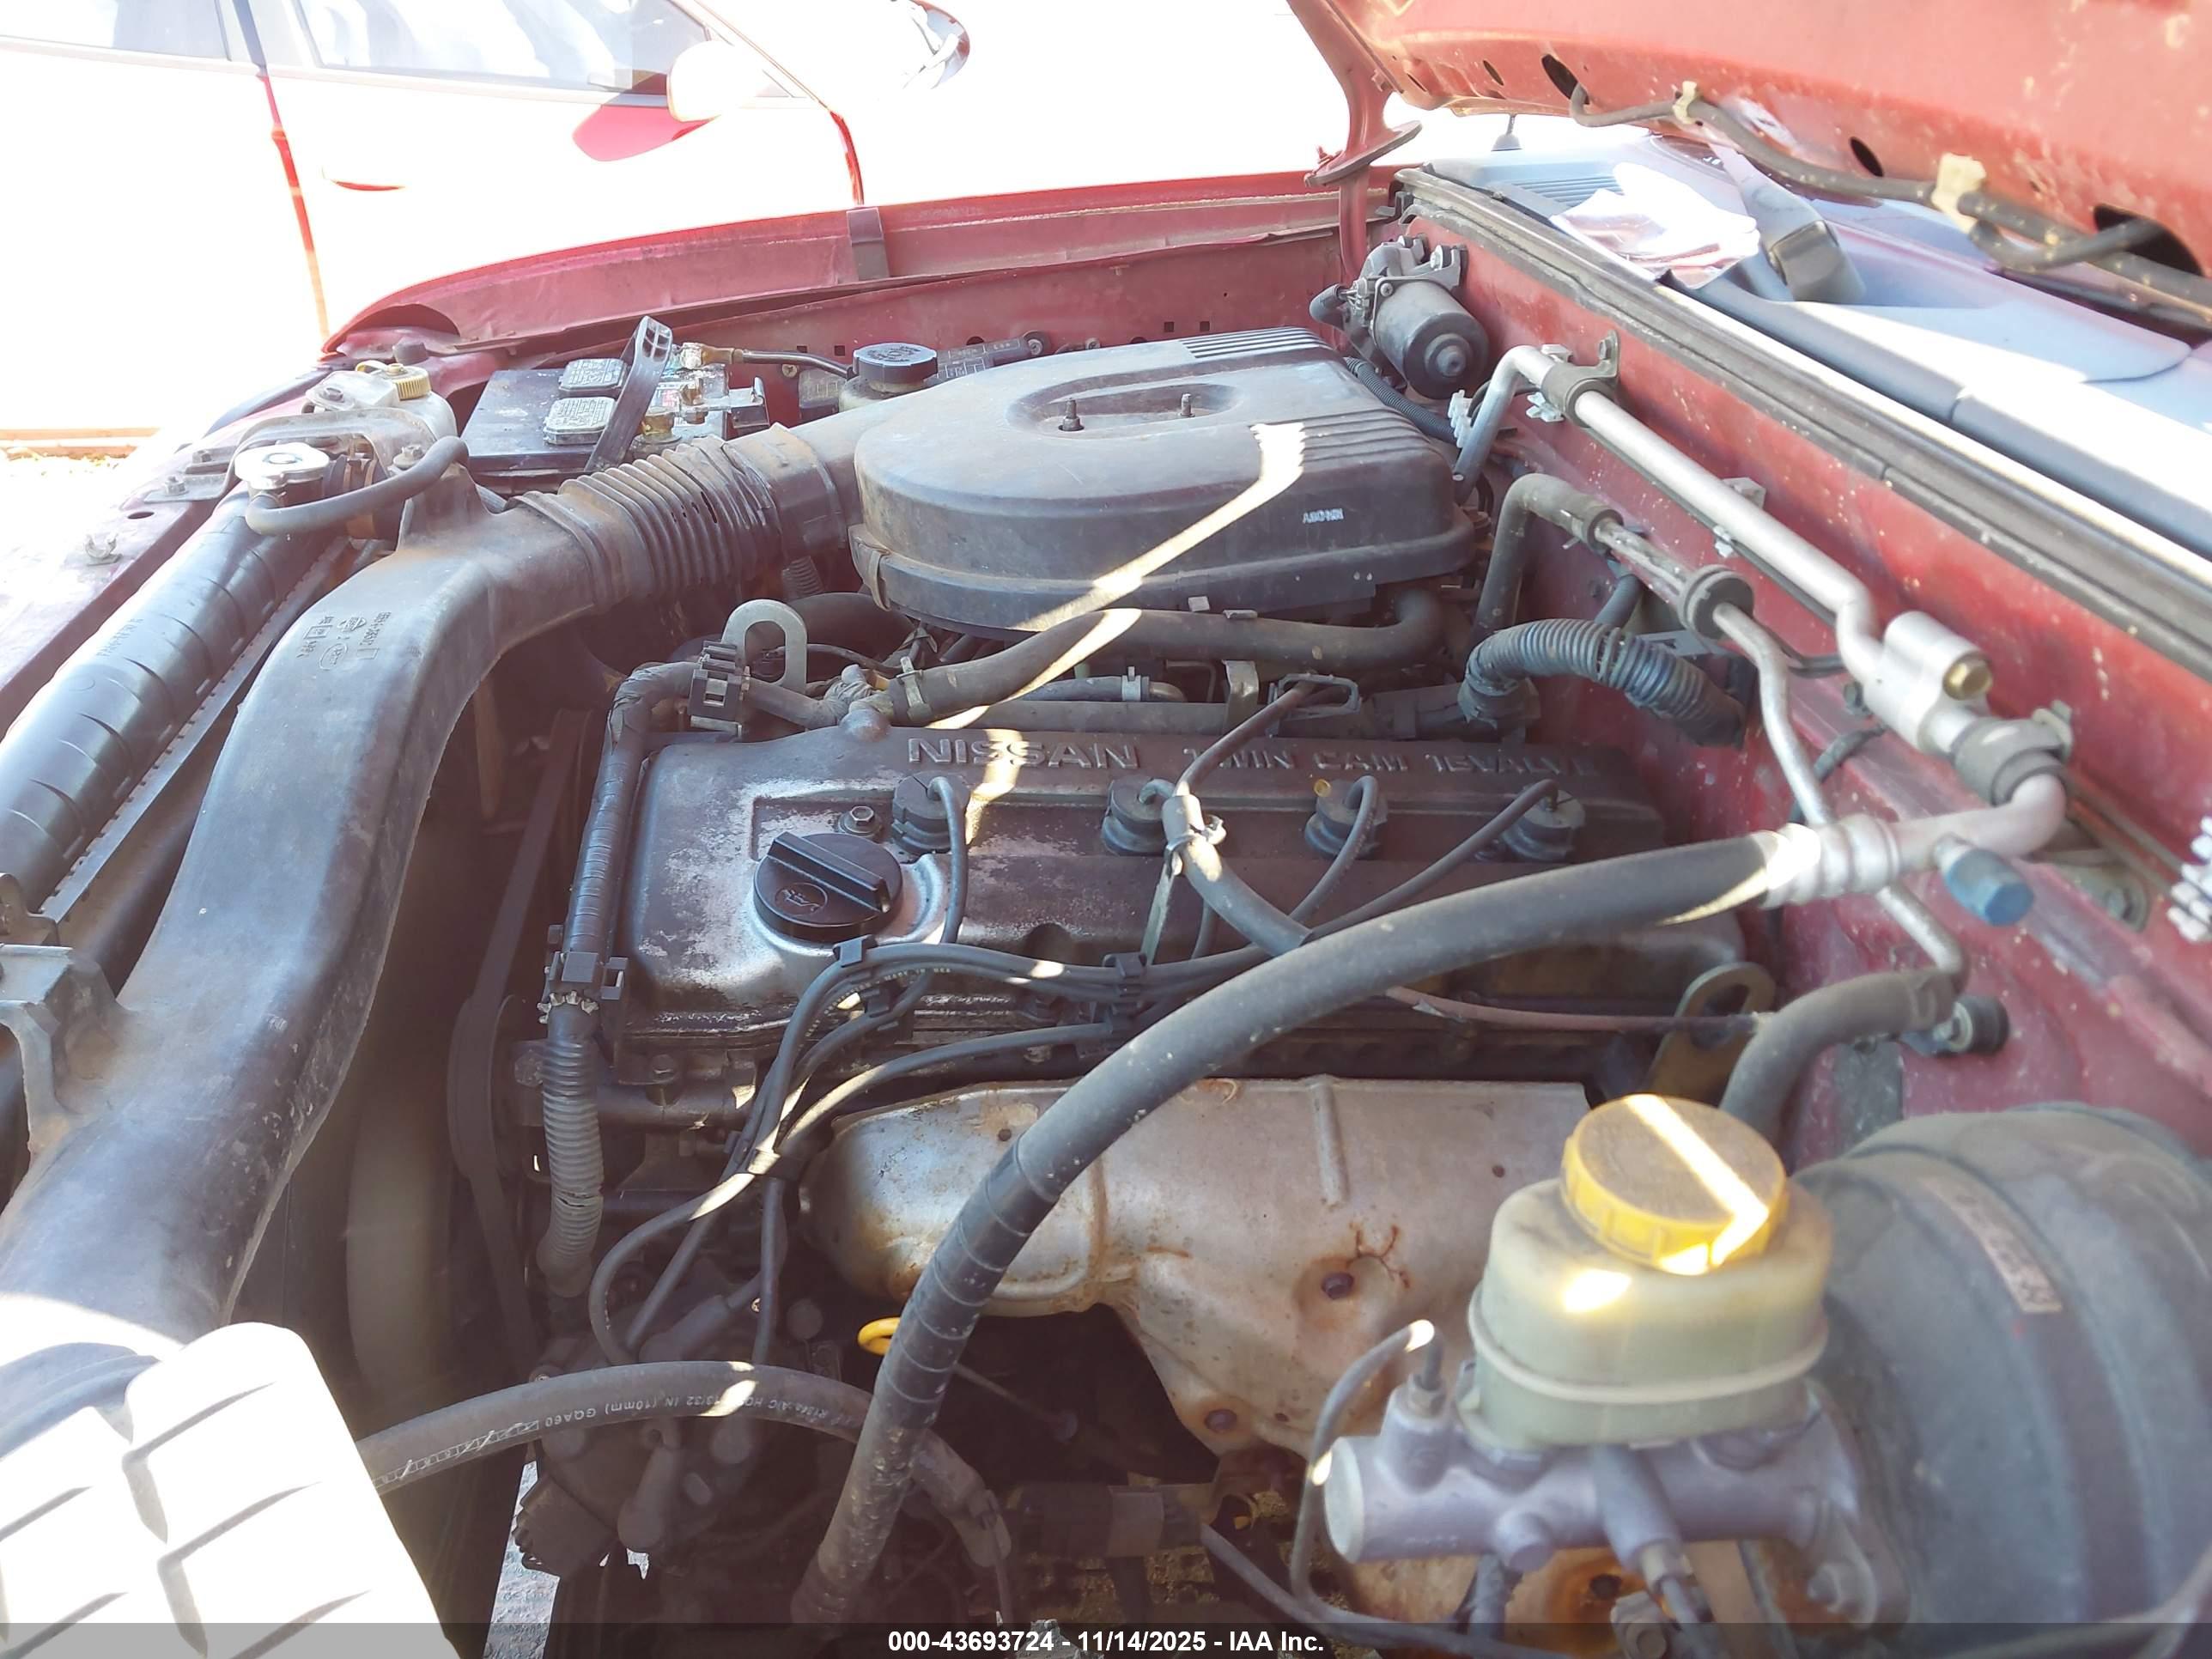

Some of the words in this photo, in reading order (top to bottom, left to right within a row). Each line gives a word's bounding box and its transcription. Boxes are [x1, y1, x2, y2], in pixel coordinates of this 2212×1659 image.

[907, 737, 1139, 769] NISSAN
[1312, 750, 1409, 772] CAM
[544, 1407, 597, 1427] GQA60
